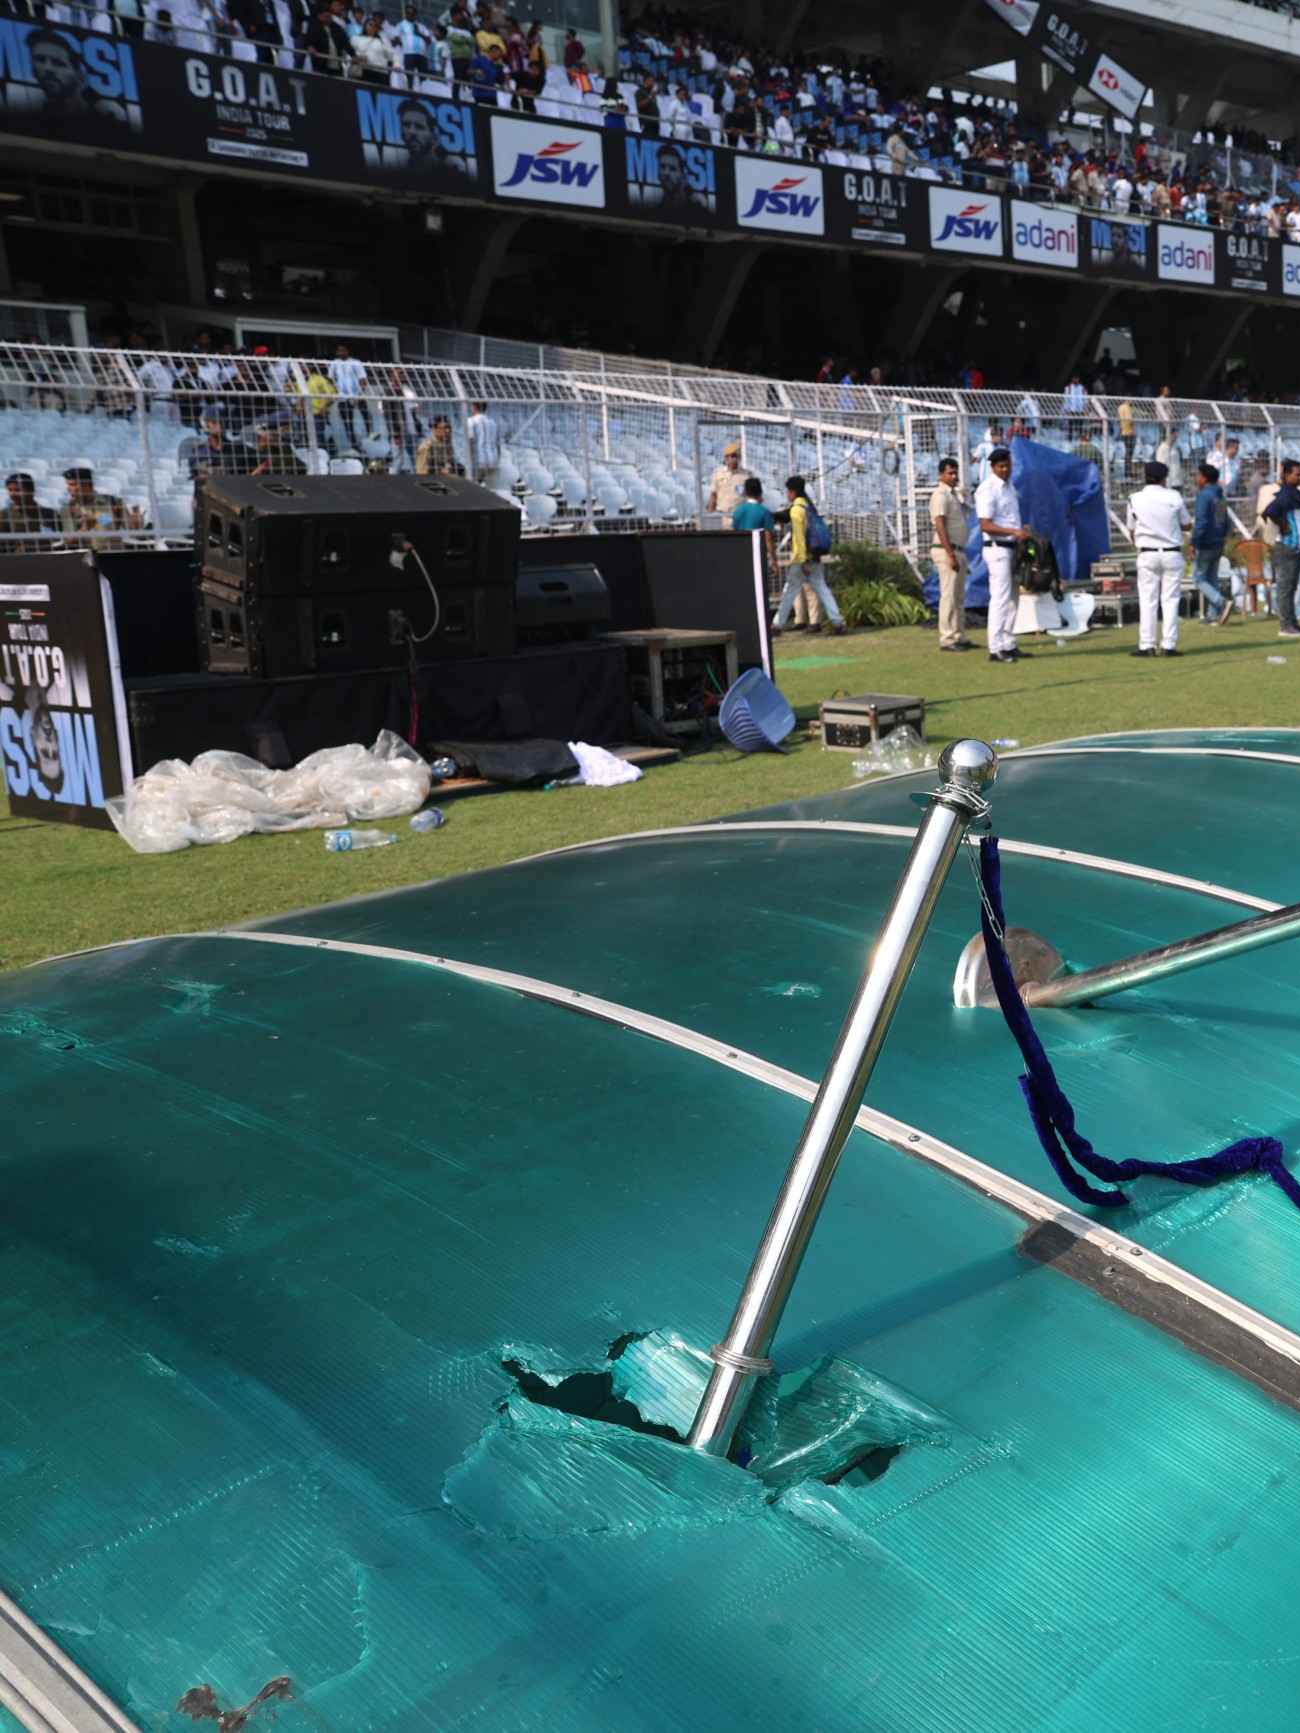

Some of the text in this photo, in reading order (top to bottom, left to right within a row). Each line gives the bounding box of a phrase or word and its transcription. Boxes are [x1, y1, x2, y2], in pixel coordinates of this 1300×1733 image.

[185, 58, 307, 115] G.O.A.T
[216, 104, 290, 131] INDIA TOUR
[499, 153, 600, 188] JSW
[741, 188, 820, 218] JSW
[844, 172, 907, 208] G.O.A.T
[934, 215, 998, 241] JSW
[1016, 219, 1075, 254] adani
[1161, 241, 1212, 271] adani
[2, 643, 67, 689] G.O.A.T
